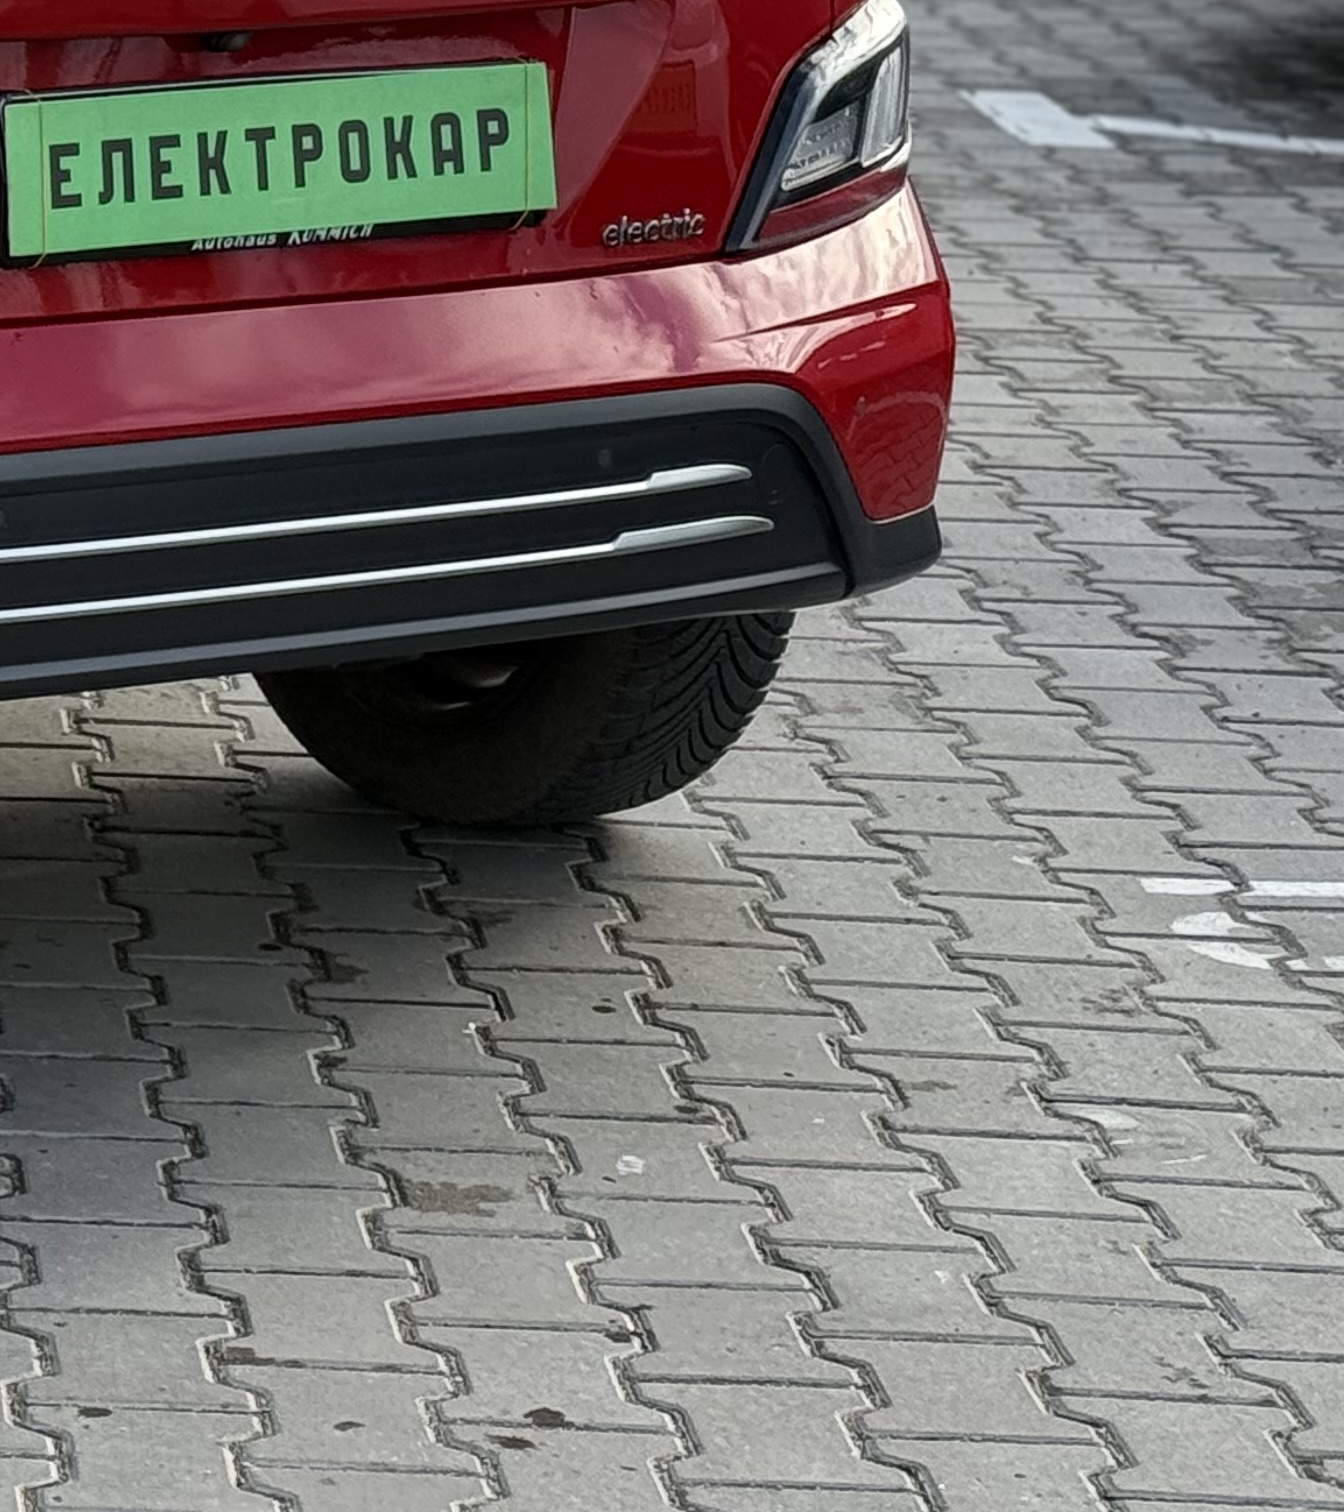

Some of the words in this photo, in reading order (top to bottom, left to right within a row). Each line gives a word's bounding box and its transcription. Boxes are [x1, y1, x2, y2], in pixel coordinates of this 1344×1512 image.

[47, 107, 511, 211] ЕЛЕКТРОКАР
[191, 231, 277, 252] Autohaus
[602, 207, 707, 249] electric
